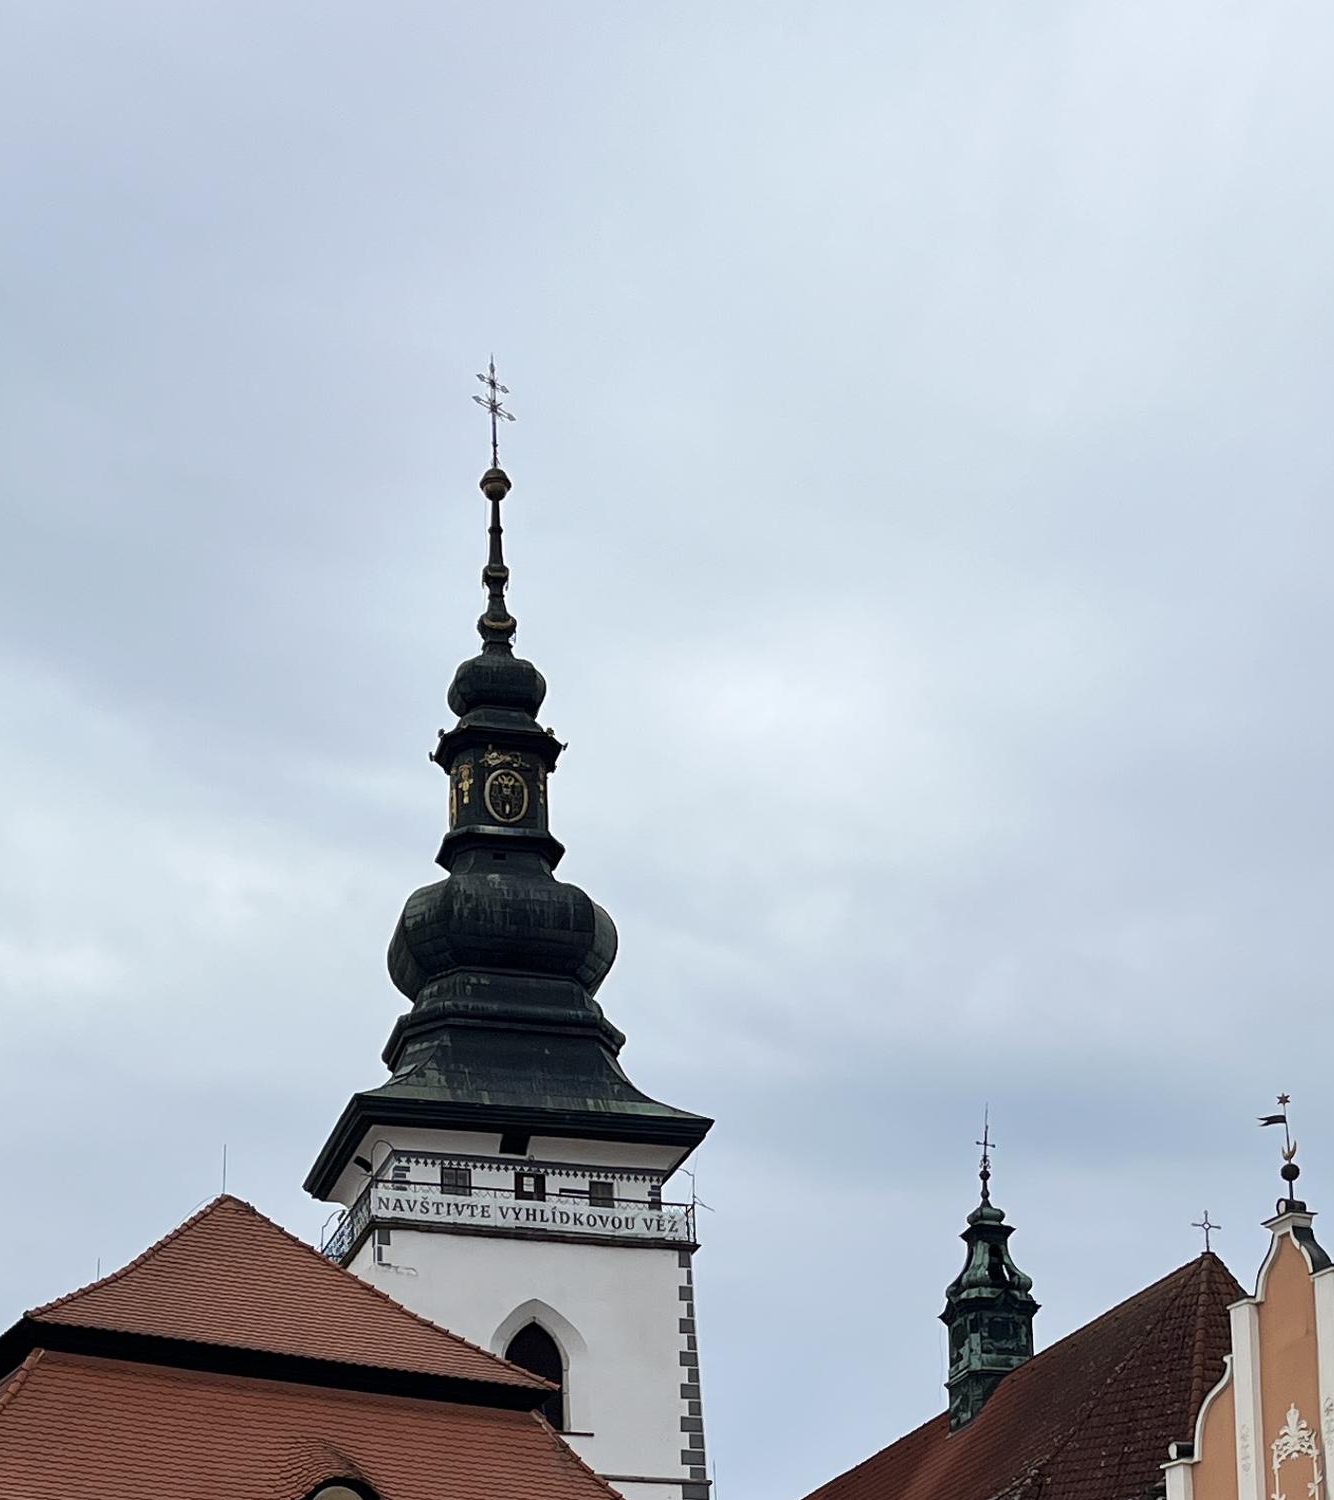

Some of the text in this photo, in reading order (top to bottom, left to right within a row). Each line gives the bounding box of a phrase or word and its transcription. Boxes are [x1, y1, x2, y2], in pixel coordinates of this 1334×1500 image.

[377, 1196, 679, 1233] NAVŠTIVTE VYHLÍDKOVOU VĚŽ
